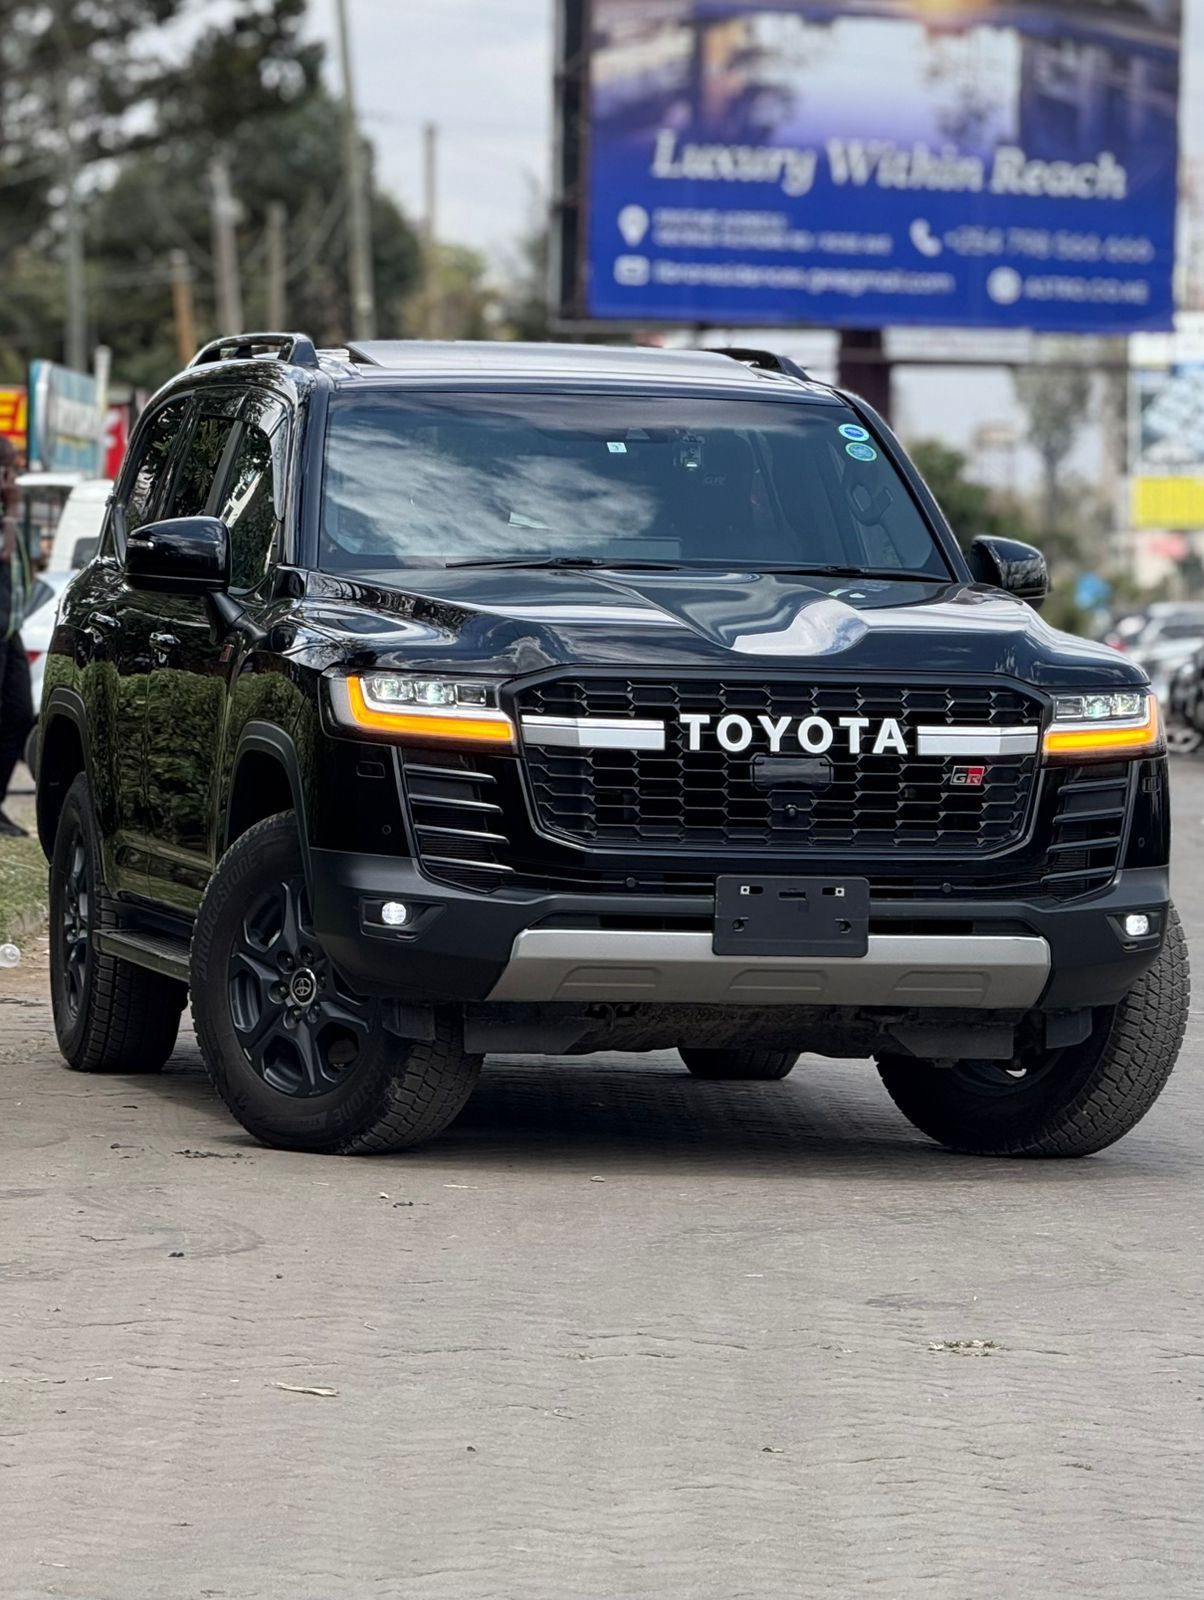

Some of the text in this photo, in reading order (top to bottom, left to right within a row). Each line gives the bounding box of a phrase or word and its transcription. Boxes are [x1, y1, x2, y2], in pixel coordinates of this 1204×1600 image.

[650, 127, 1127, 200] Luxury Within Reach
[680, 713, 908, 755] TOYOTA
[951, 771, 983, 785] GR
[193, 849, 261, 982] BRIDGESTONE
